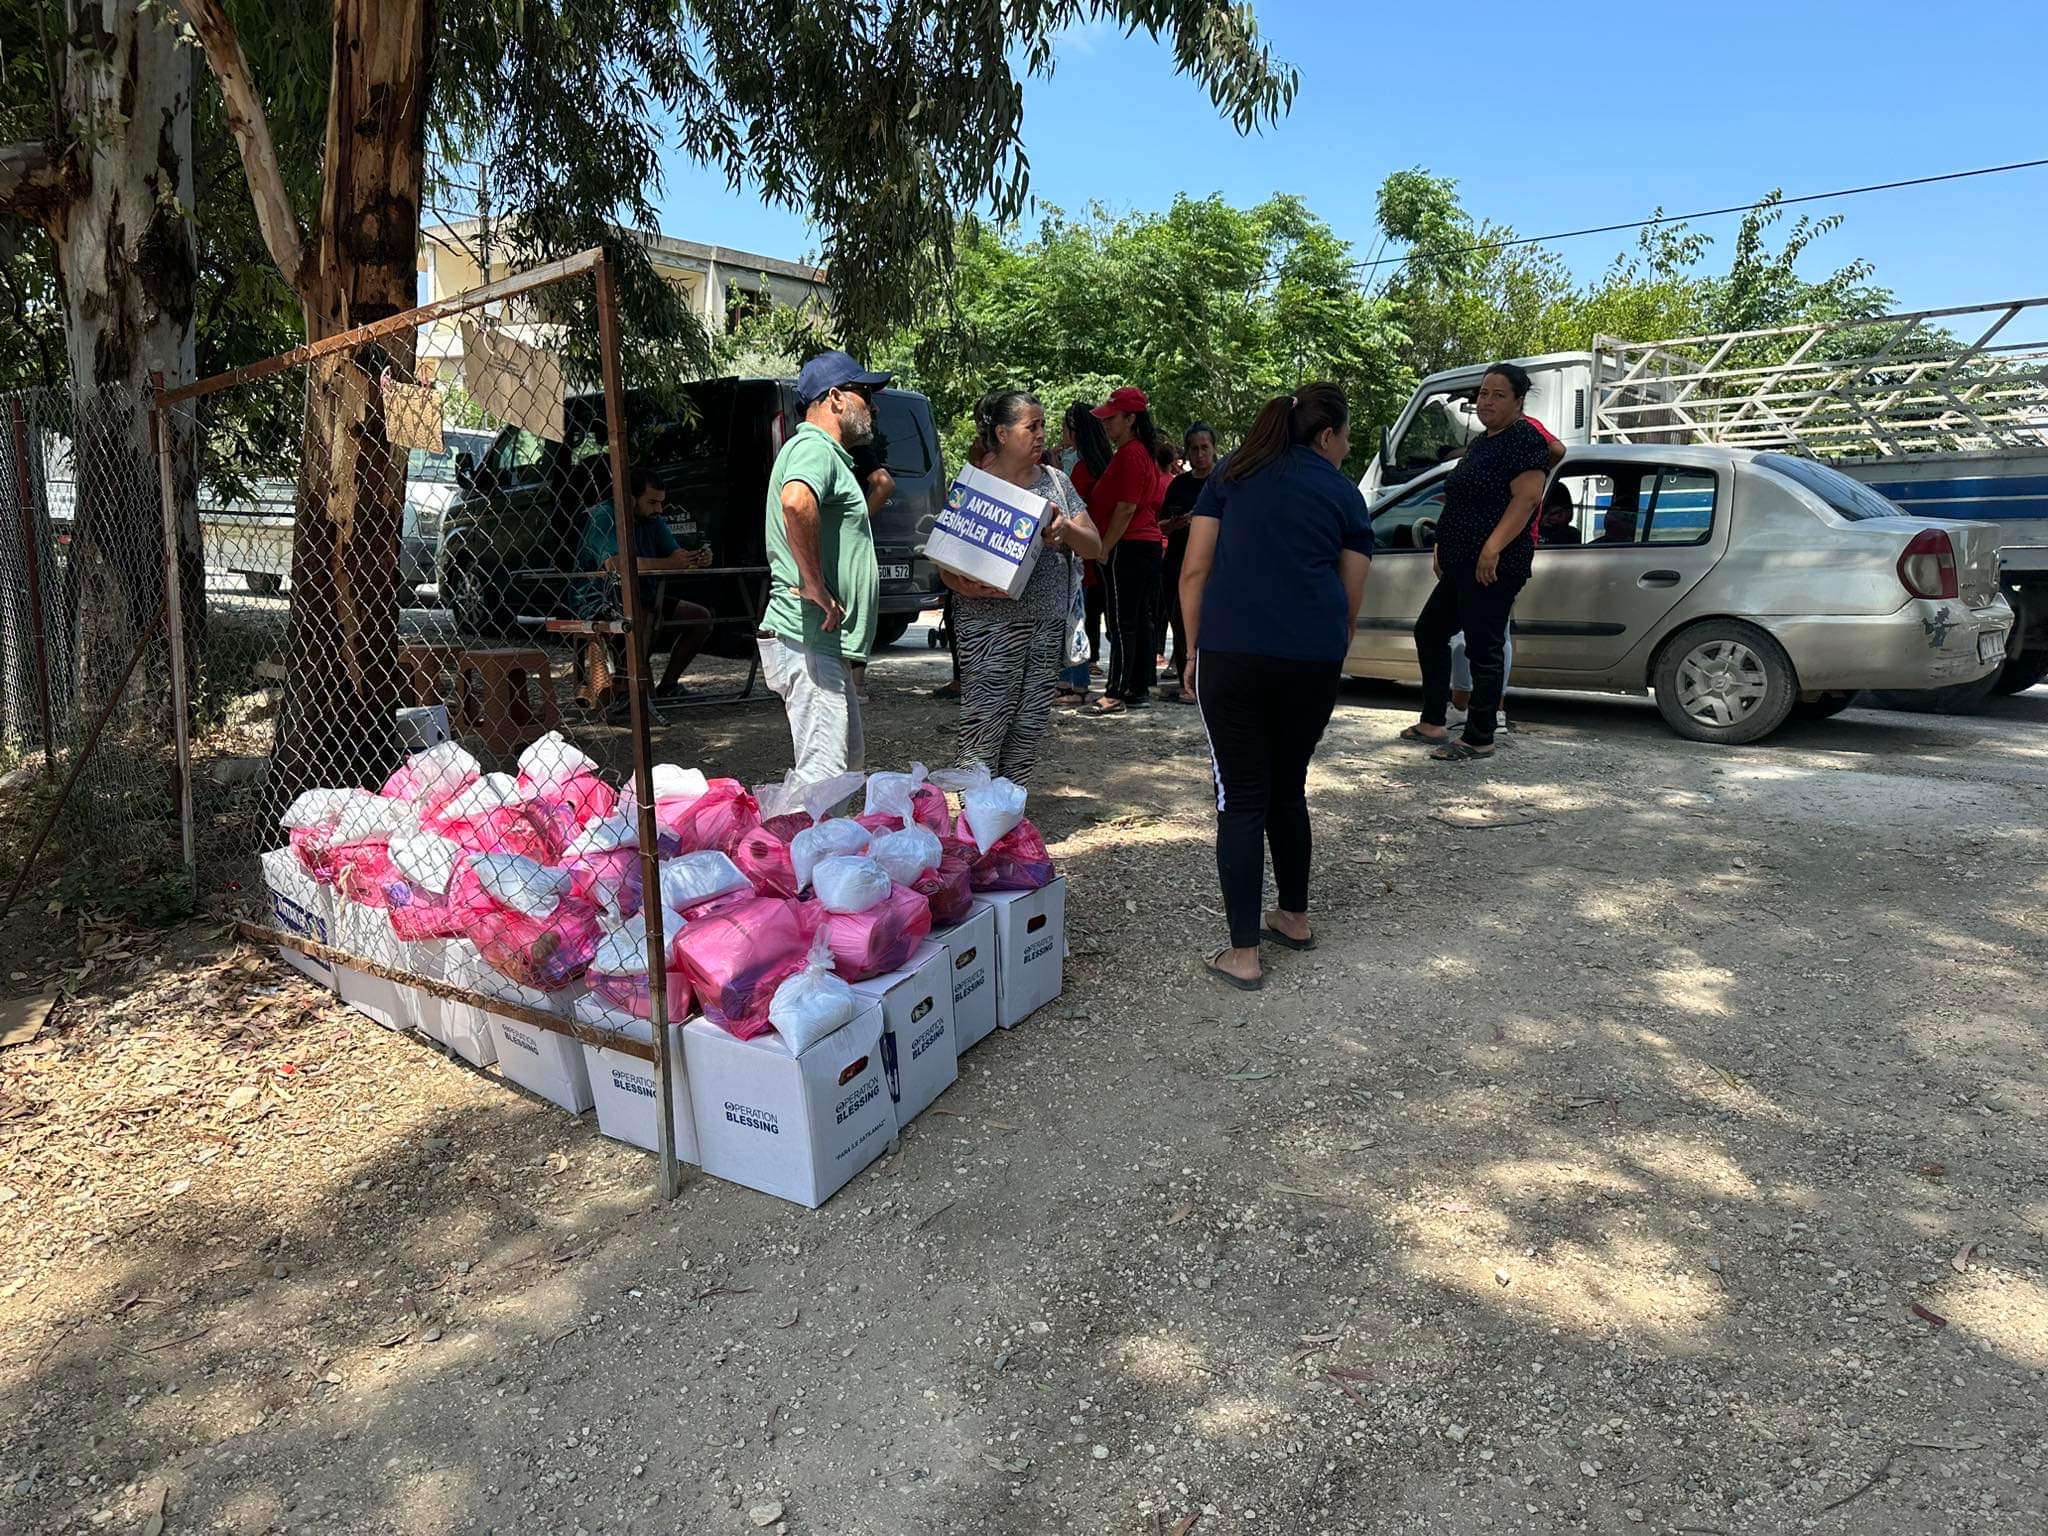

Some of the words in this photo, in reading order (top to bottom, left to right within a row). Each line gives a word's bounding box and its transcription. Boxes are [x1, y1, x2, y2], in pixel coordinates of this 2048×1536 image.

[966, 496, 1012, 528] ANTAKYA
[895, 566, 908, 577] 572
[1024, 942, 1053, 964] BLESSING
[955, 976, 984, 1002] BLESSING
[504, 1031, 539, 1055] BLESSING
[912, 1016, 944, 1050] OPERATION
[913, 1025, 944, 1060] BLESSING
[836, 1075, 880, 1113] OPERATION
[836, 1085, 880, 1125] BLESSING
[724, 1101, 778, 1123] OPERATION
[726, 1111, 779, 1135] BLESSING
